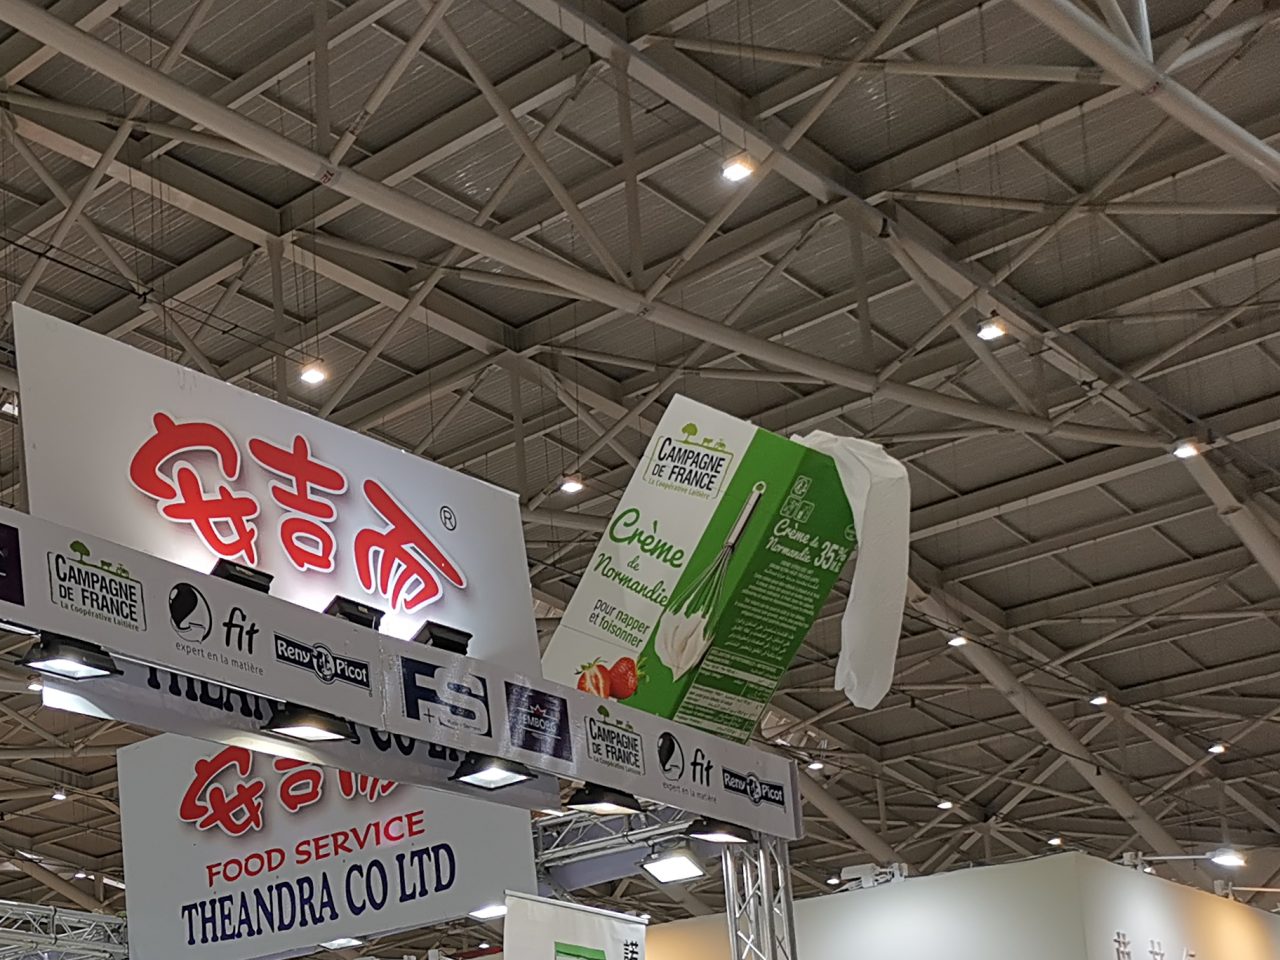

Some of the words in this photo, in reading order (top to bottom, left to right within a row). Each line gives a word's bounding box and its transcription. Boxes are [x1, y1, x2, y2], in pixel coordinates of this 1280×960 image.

[657, 437, 726, 475] CAMPAGNE
[652, 464, 667, 478] DE
[668, 465, 718, 492] FRANCE
[608, 507, 685, 569] Crème
[773, 519, 810, 545] Crème
[55, 554, 137, 604] CAMPAGNE
[594, 553, 669, 607] Normandie
[627, 555, 640, 572] de
[59, 585, 74, 601] DE
[81, 590, 138, 622] FRANCE
[60, 600, 69, 609] La
[70, 603, 113, 624] Coopérative
[113, 614, 140, 632] Laitière
[594, 600, 615, 620] pour
[615, 607, 650, 636] napper
[222, 606, 260, 655] fit
[589, 613, 597, 625] et
[598, 615, 644, 649] foisonner
[175, 641, 206, 659] expert
[207, 650, 219, 661] en
[220, 652, 229, 664] la
[231, 658, 264, 676] matière
[277, 639, 311, 664] Reny
[336, 661, 368, 684] Picot
[400, 656, 493, 739] FS
[589, 717, 639, 753] CAMPAGNE
[593, 743, 603, 755] DE
[606, 744, 640, 769] FRANCE
[691, 748, 714, 787] fit
[724, 773, 746, 791] Reny
[761, 784, 783, 802] Picot
[207, 848, 286, 888] FOOD
[295, 811, 426, 867] SERVICE
[181, 878, 340, 946] THEANDRA
[345, 859, 389, 916] CO
[397, 843, 457, 903] LTD
